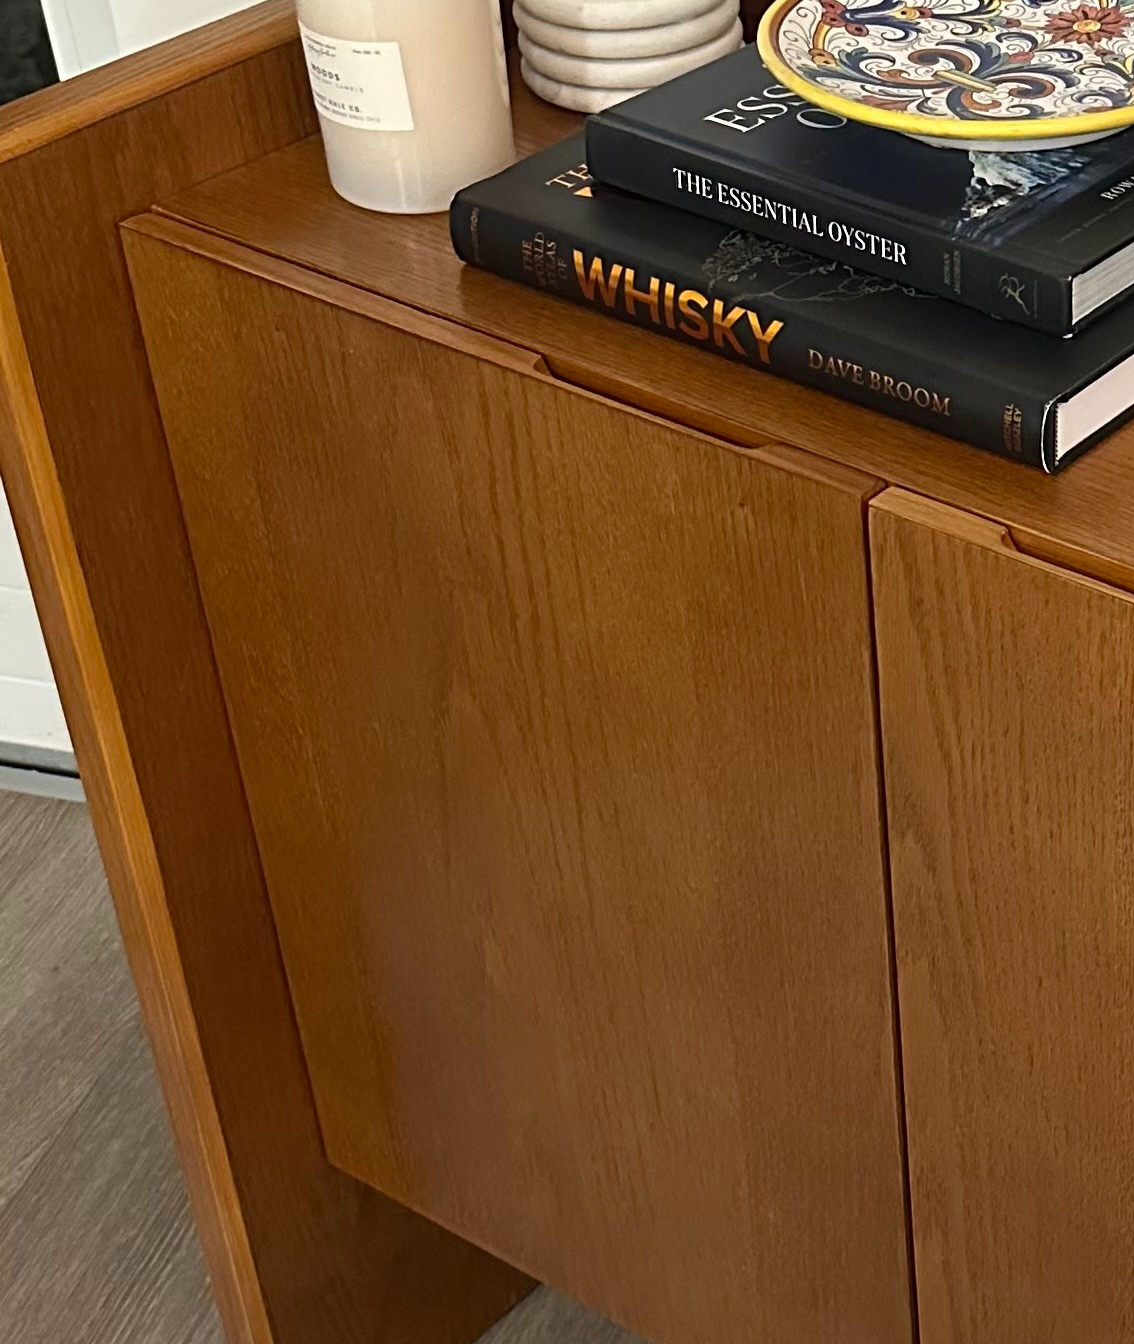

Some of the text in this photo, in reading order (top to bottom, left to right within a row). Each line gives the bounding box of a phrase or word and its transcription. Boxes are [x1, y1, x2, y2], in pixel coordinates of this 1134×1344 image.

[703, 84, 809, 133] ESS
[796, 108, 848, 129] O
[544, 163, 594, 189] TH
[672, 167, 907, 266] THE ESSENTIAL OYSTER
[522, 240, 533, 273] THE
[572, 248, 784, 365] WHISKY
[808, 348, 951, 417] DAVE BROOM
